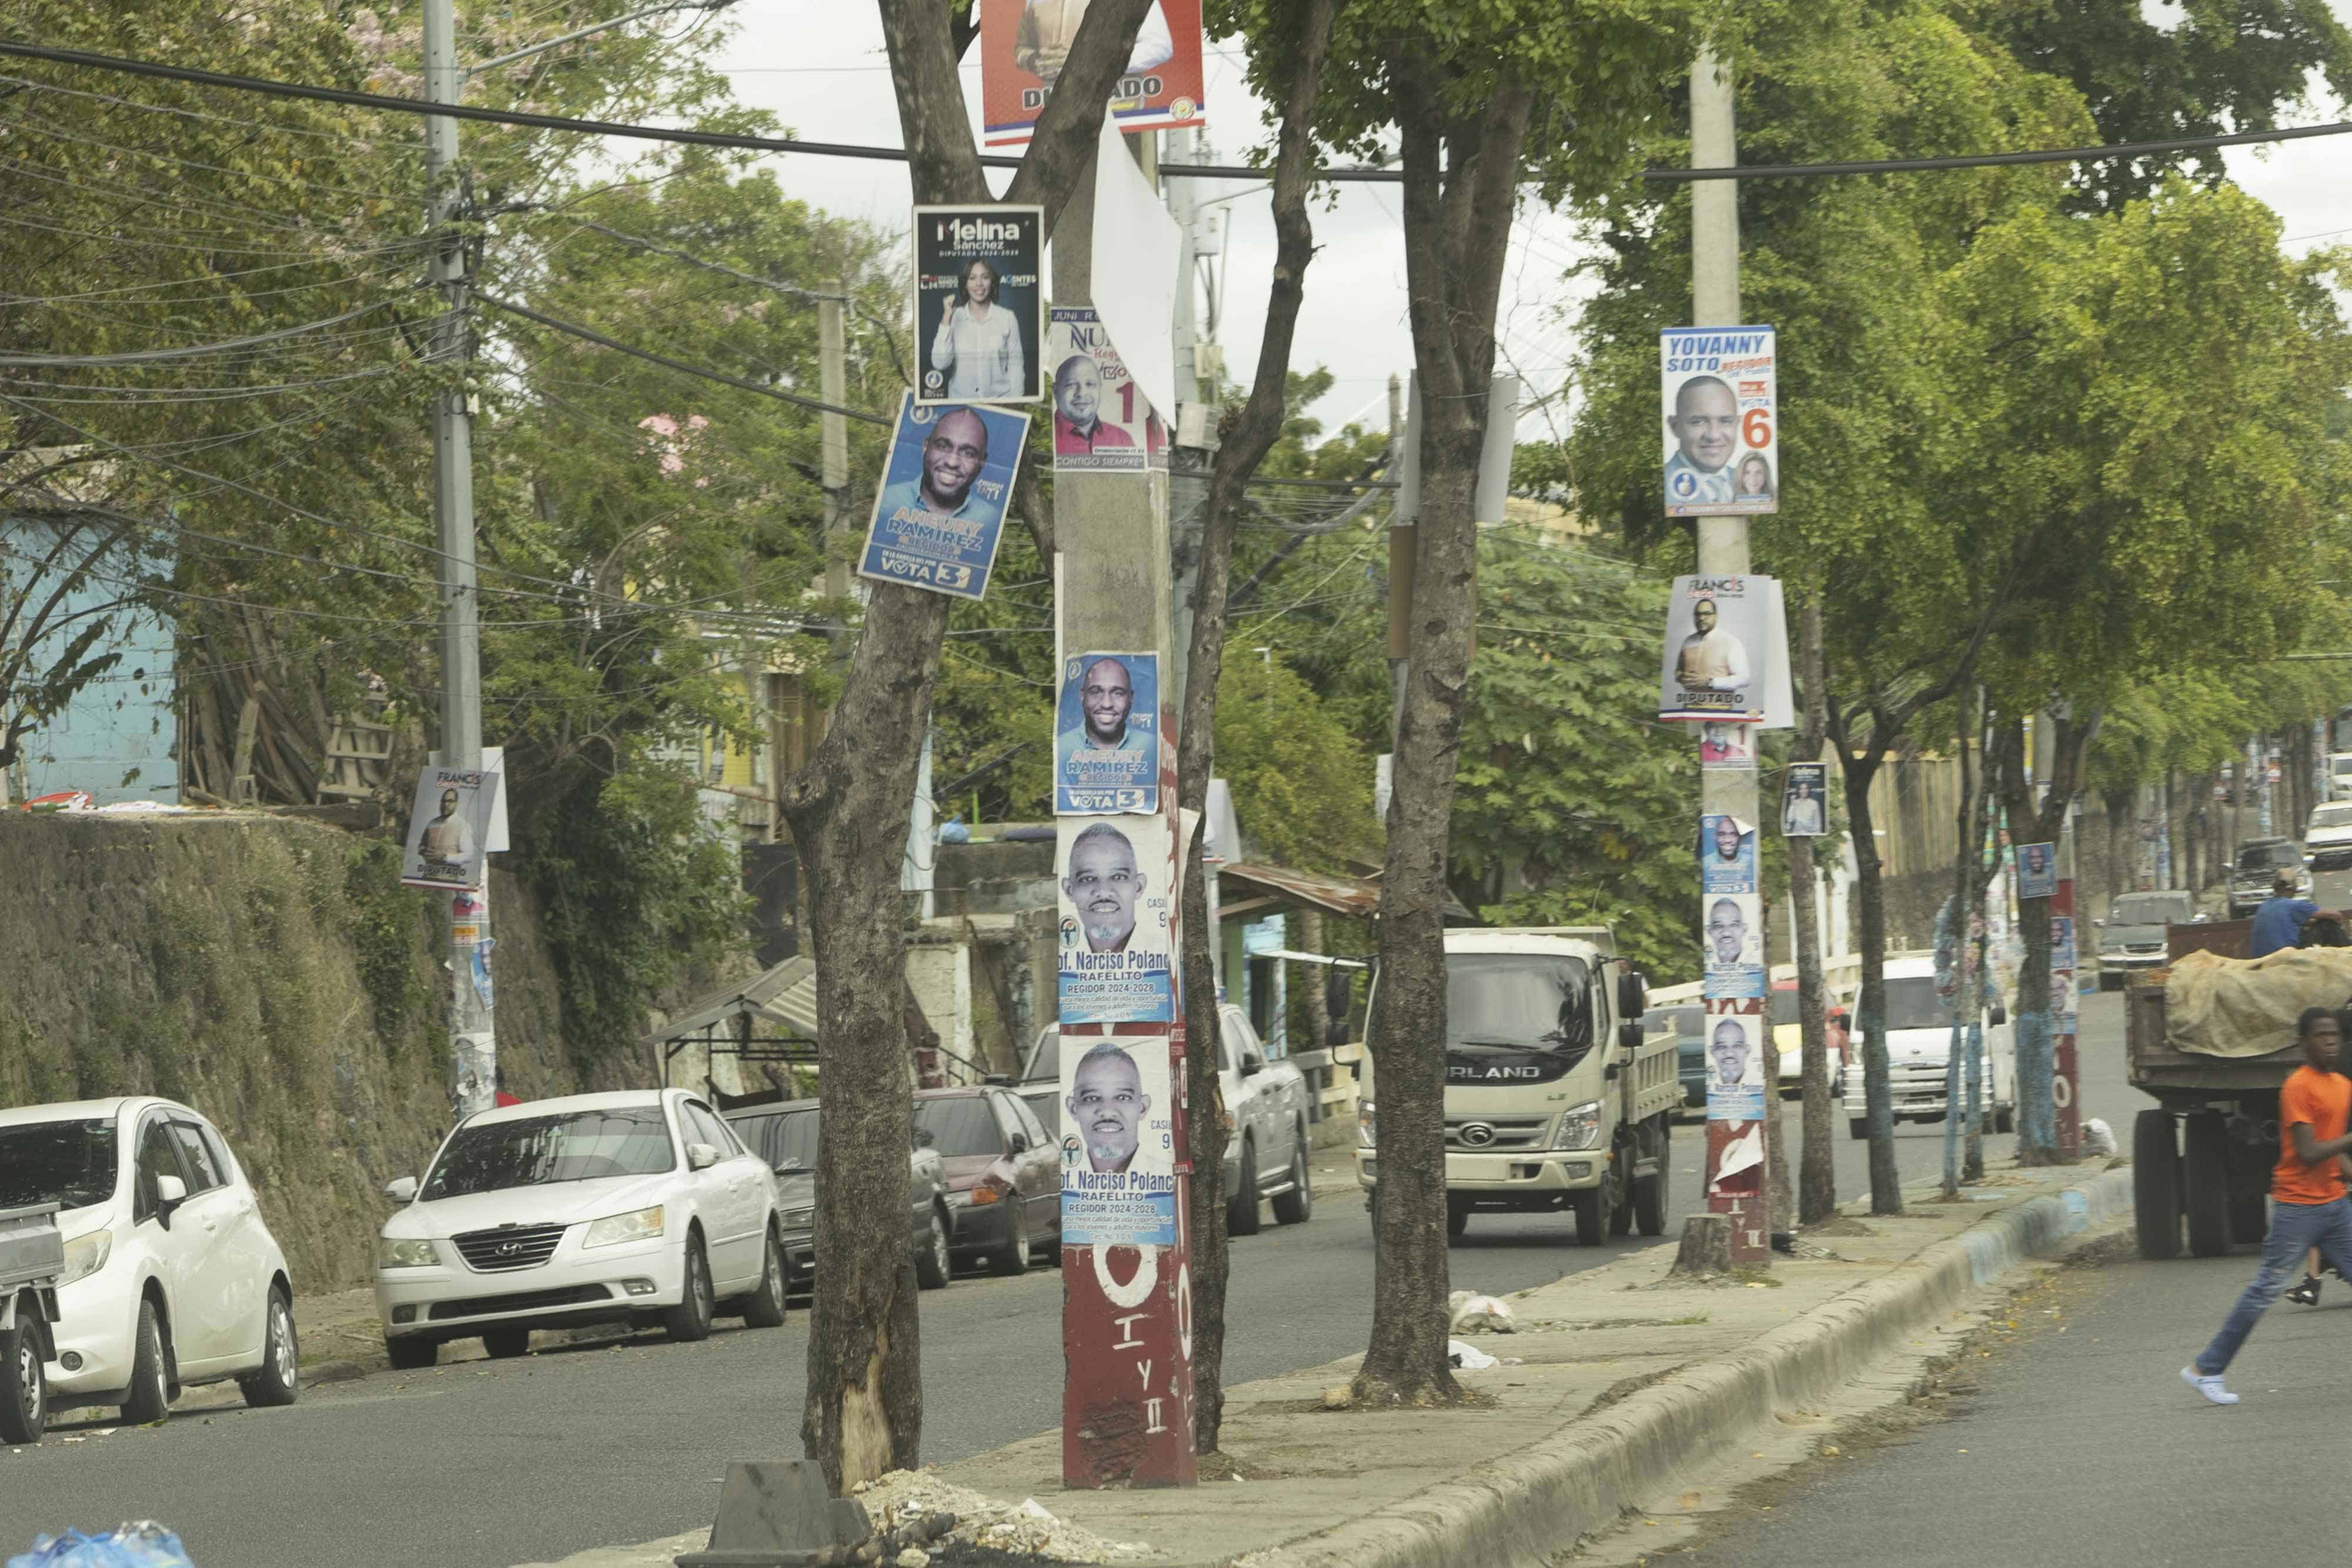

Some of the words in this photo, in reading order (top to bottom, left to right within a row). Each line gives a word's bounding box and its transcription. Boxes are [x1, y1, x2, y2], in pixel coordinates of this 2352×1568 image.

[937, 218, 1020, 241] Melina
[1670, 335, 1766, 356] YOVANNY
[1666, 357, 1720, 372] SOTO
[1116, 382, 1134, 423] 1
[1742, 409, 1772, 449] 6
[886, 517, 984, 552] RAMIREZ
[881, 557, 930, 580] VOTA
[1676, 693, 1743, 704] DIPUTADO
[1066, 761, 1148, 774] RAMIREZ
[1069, 794, 1113, 809] VOTA
[1119, 791, 1137, 807] 3
[1159, 912, 1167, 928] 9
[1076, 948, 1124, 970] Narciso
[1080, 971, 1142, 981] RAFELITO
[1067, 984, 1105, 994] REGIDOR
[1108, 983, 1154, 993] 2024-2028
[1444, 1066, 1541, 1078] RLAND
[1162, 1133, 1170, 1149] 9
[1078, 1170, 1125, 1189] Narciso
[1081, 1191, 1144, 1201] RAFELITO
[1068, 1204, 1107, 1213] REGIDOR
[1109, 1203, 1156, 1213] 2024-2028
